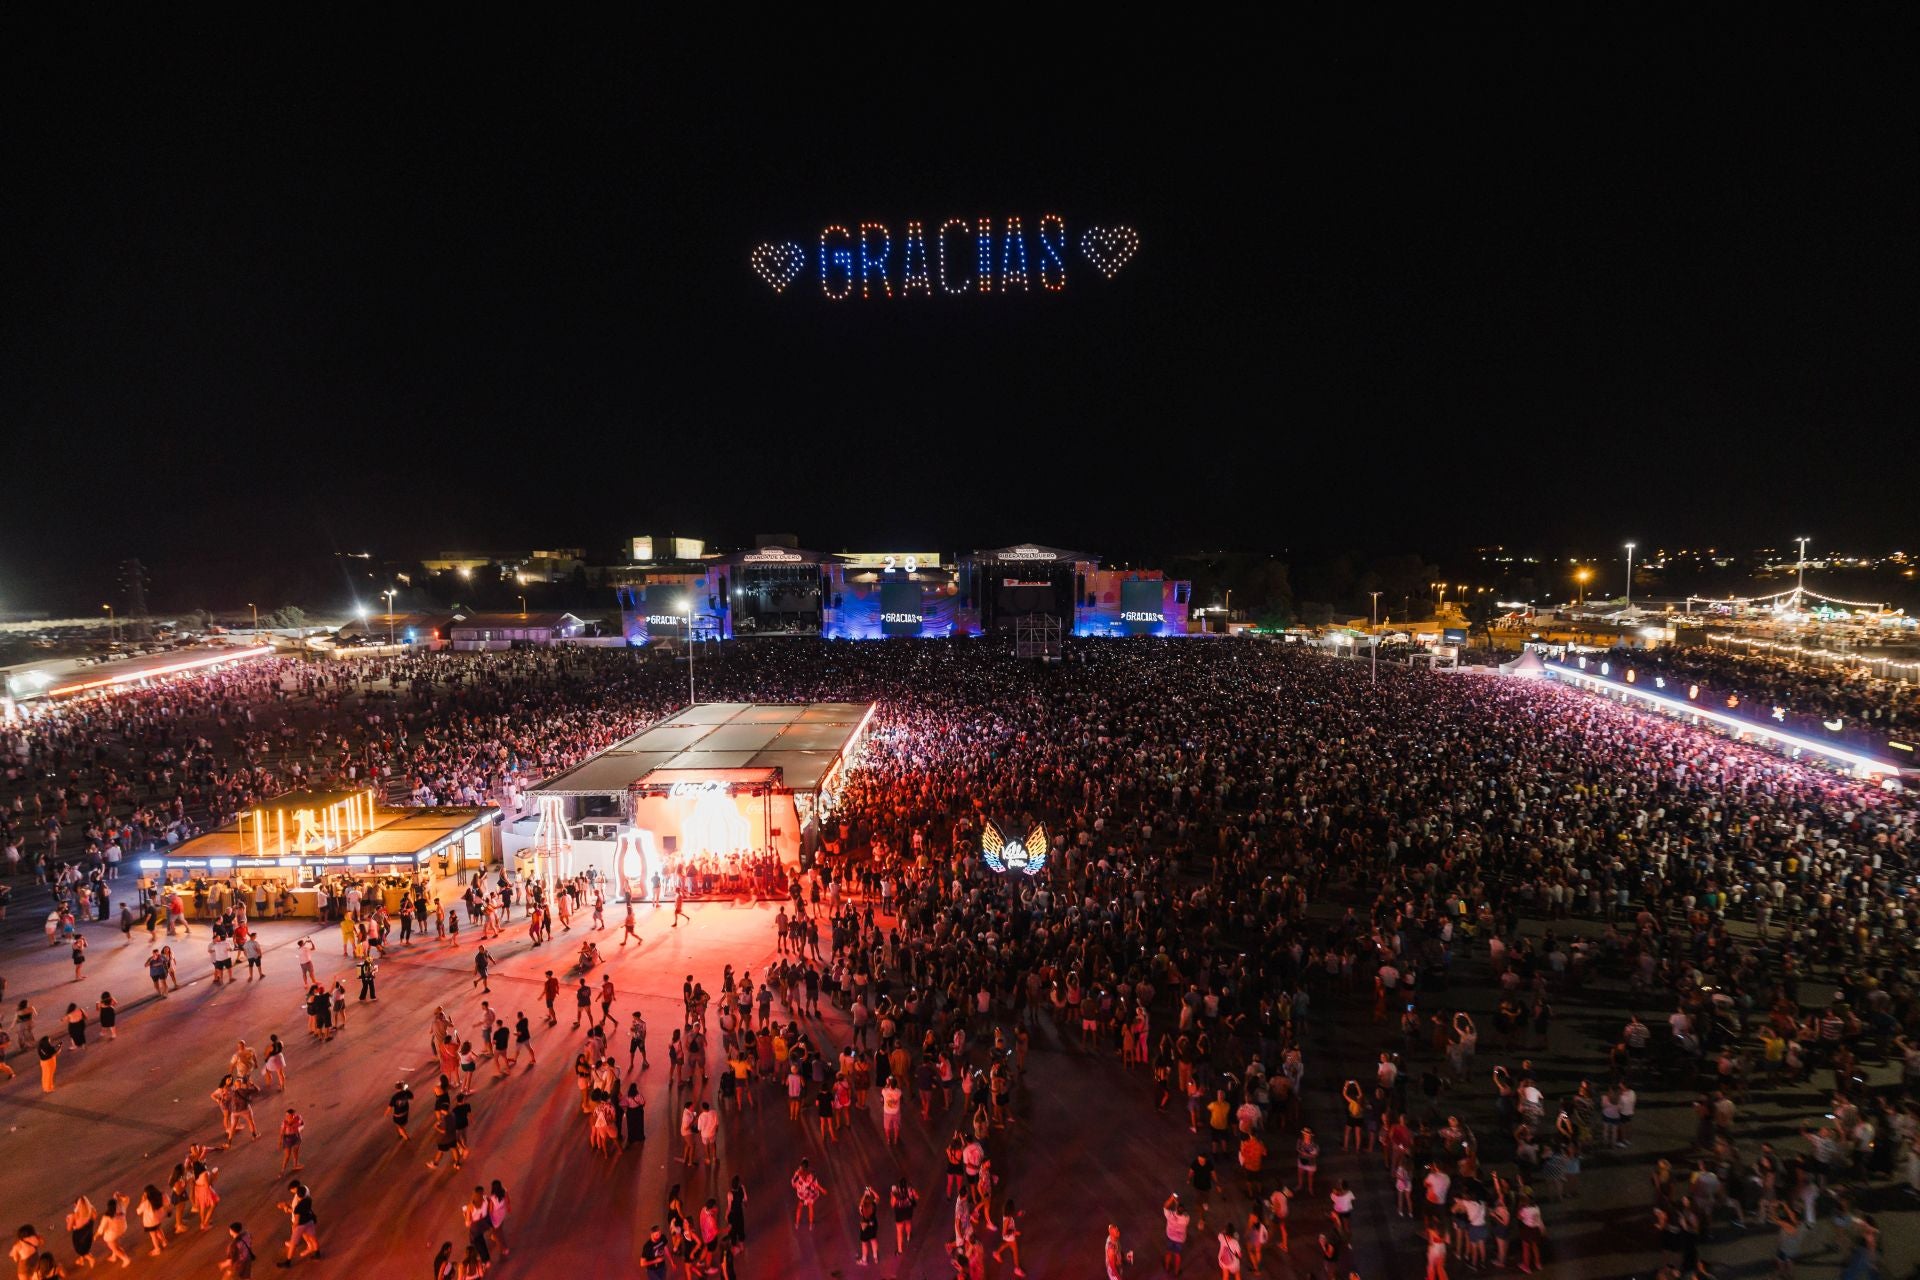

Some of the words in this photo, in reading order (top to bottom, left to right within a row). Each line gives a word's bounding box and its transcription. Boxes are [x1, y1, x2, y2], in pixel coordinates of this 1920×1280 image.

[820, 213, 1065, 299] GRACIAS
[885, 613, 917, 623] GRACIAS
[1126, 611, 1158, 621] GRACIAS
